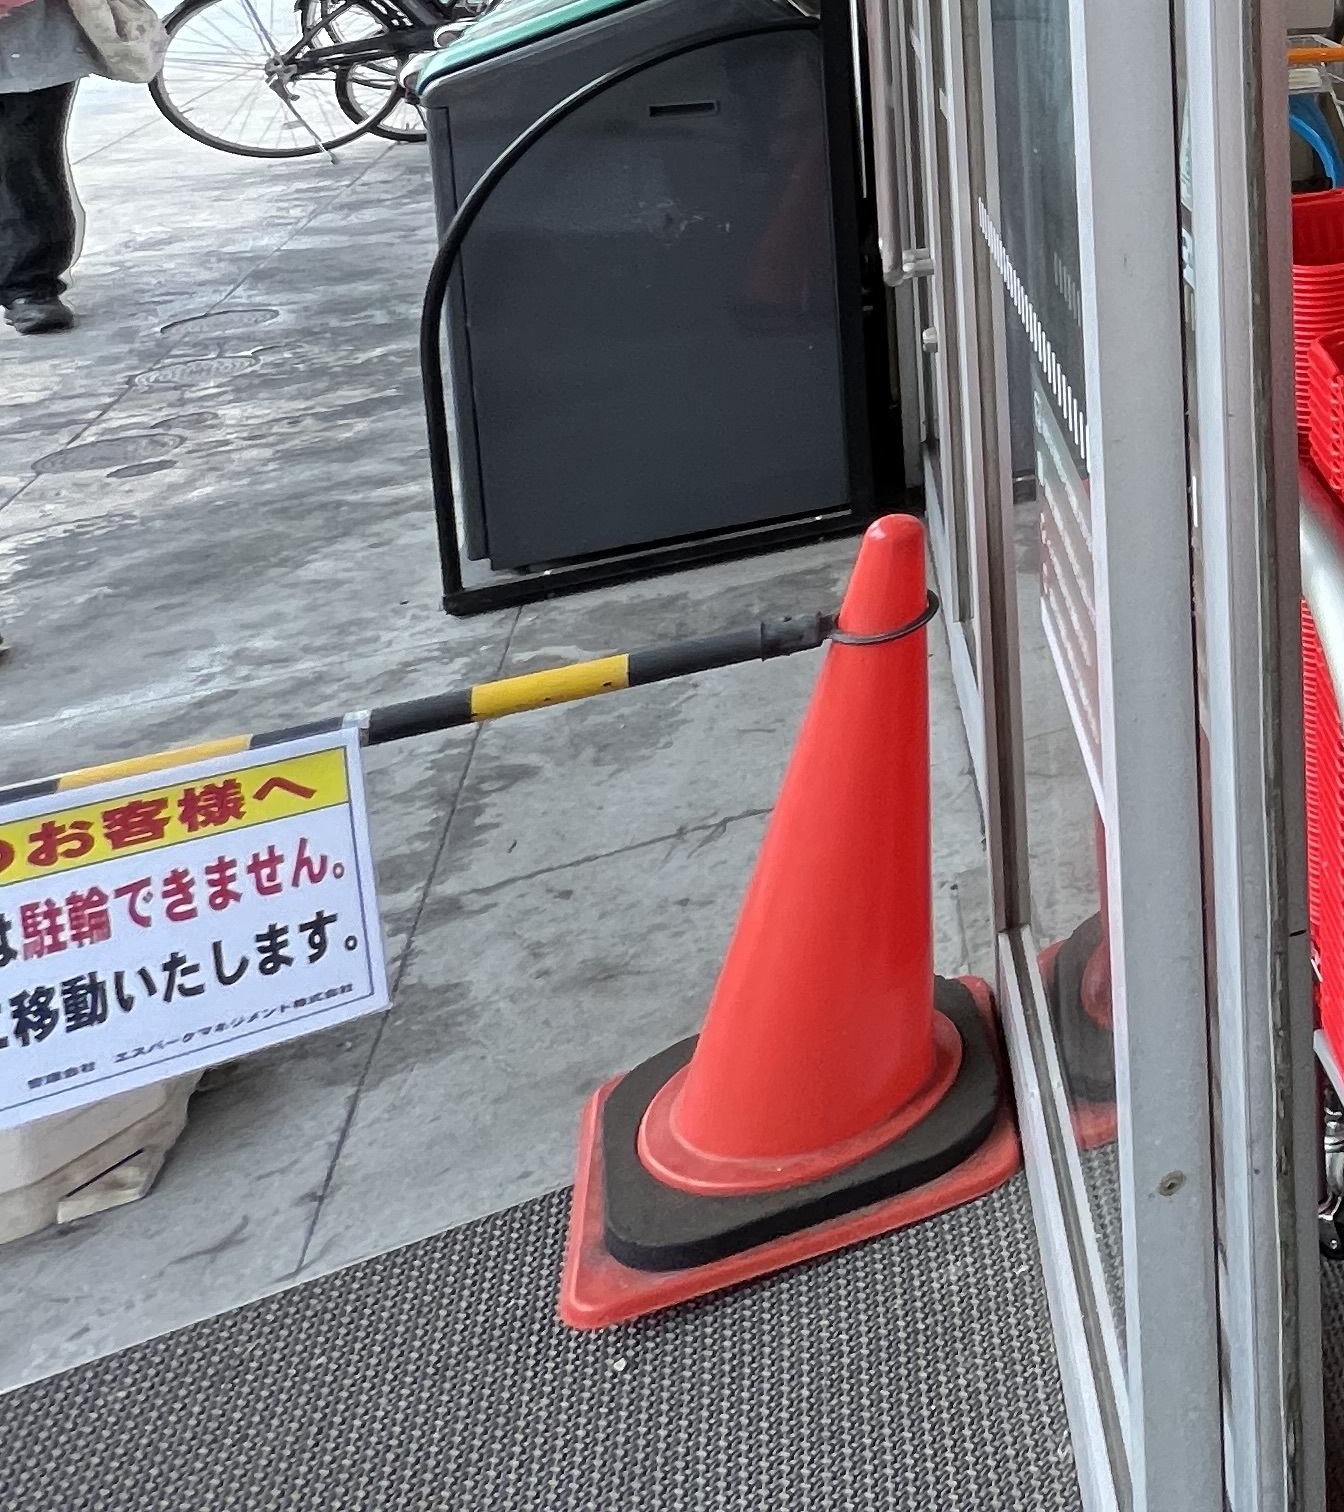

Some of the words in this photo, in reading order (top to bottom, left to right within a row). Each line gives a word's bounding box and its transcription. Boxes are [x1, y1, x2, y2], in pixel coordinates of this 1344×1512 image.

[0, 909, 358, 1050] 移動いたします。
